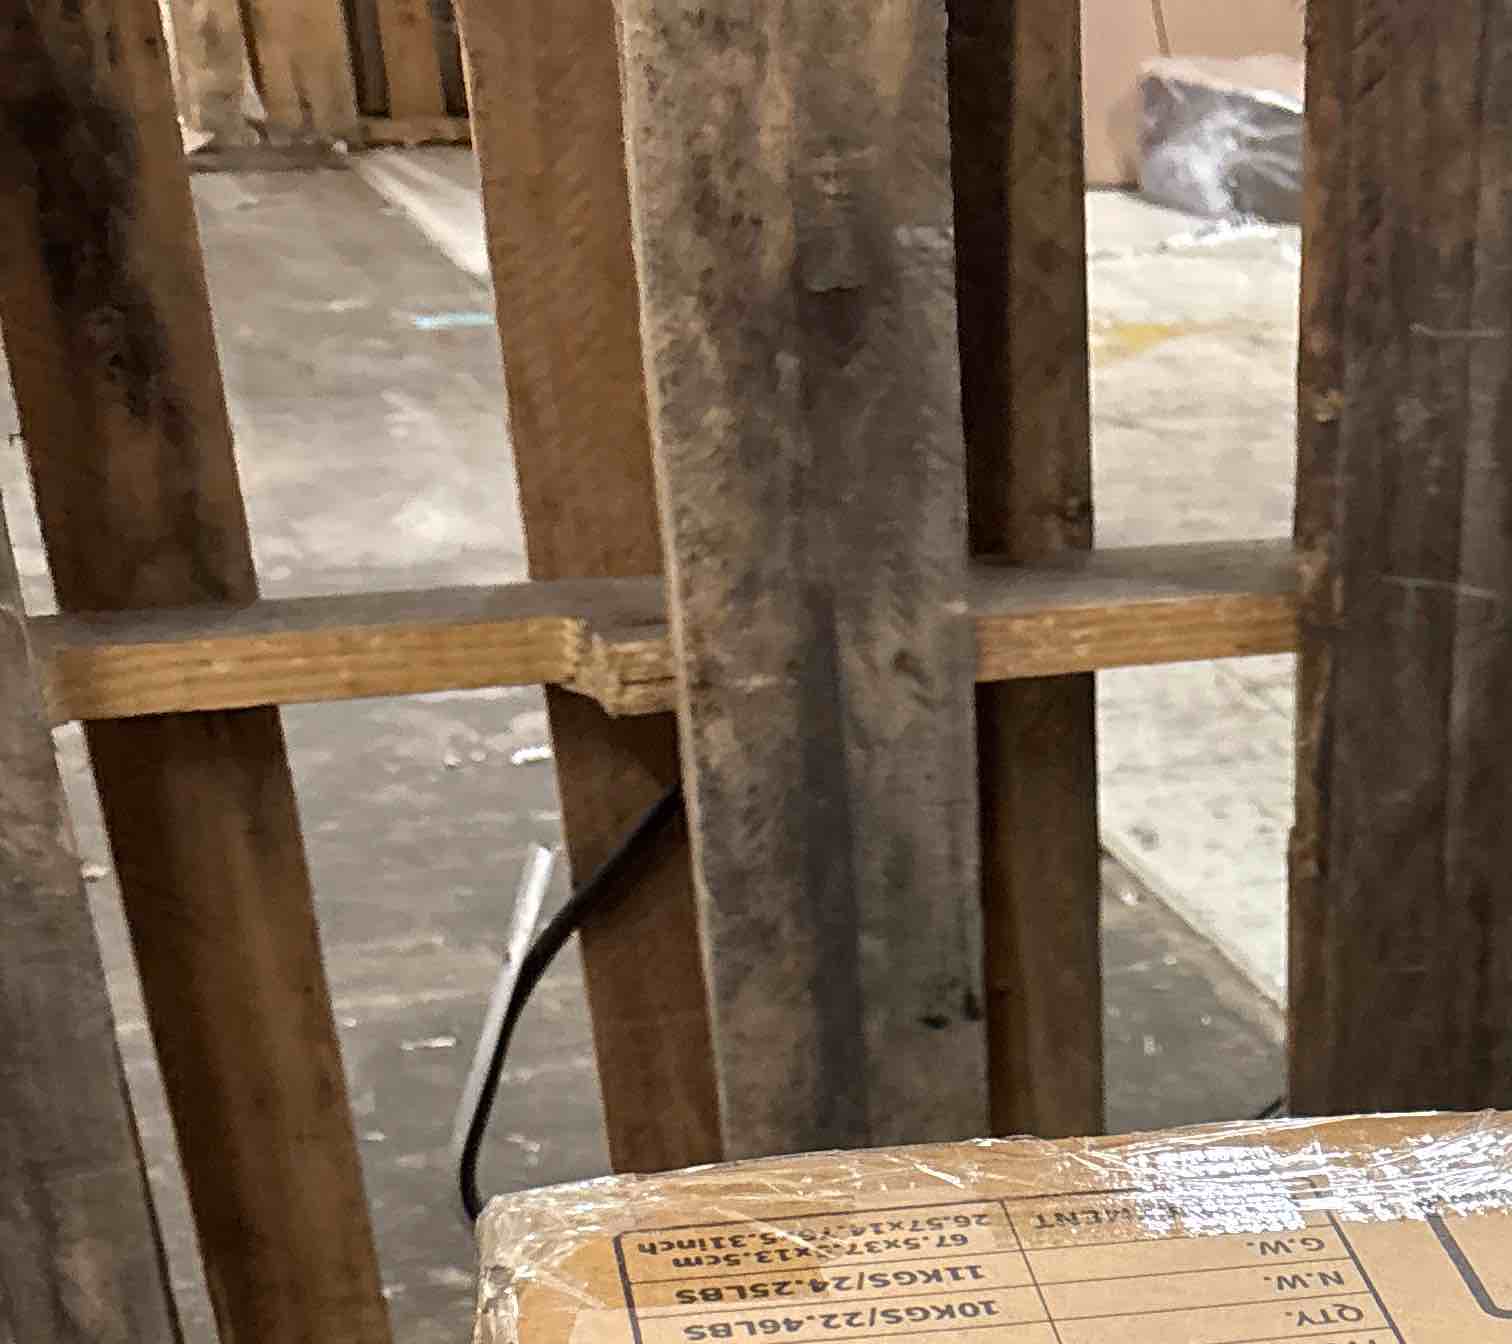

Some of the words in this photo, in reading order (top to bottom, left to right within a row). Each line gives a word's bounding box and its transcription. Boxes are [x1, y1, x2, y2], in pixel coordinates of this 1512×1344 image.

[1246, 1234, 1327, 1258] G.W.
[675, 1264, 984, 1306] 11KGS/24.25LBS
[1262, 1269, 1344, 1291] N.W.
[685, 1300, 999, 1341] 10KGS/22.46LBS
[1283, 1302, 1364, 1327] QTY.
